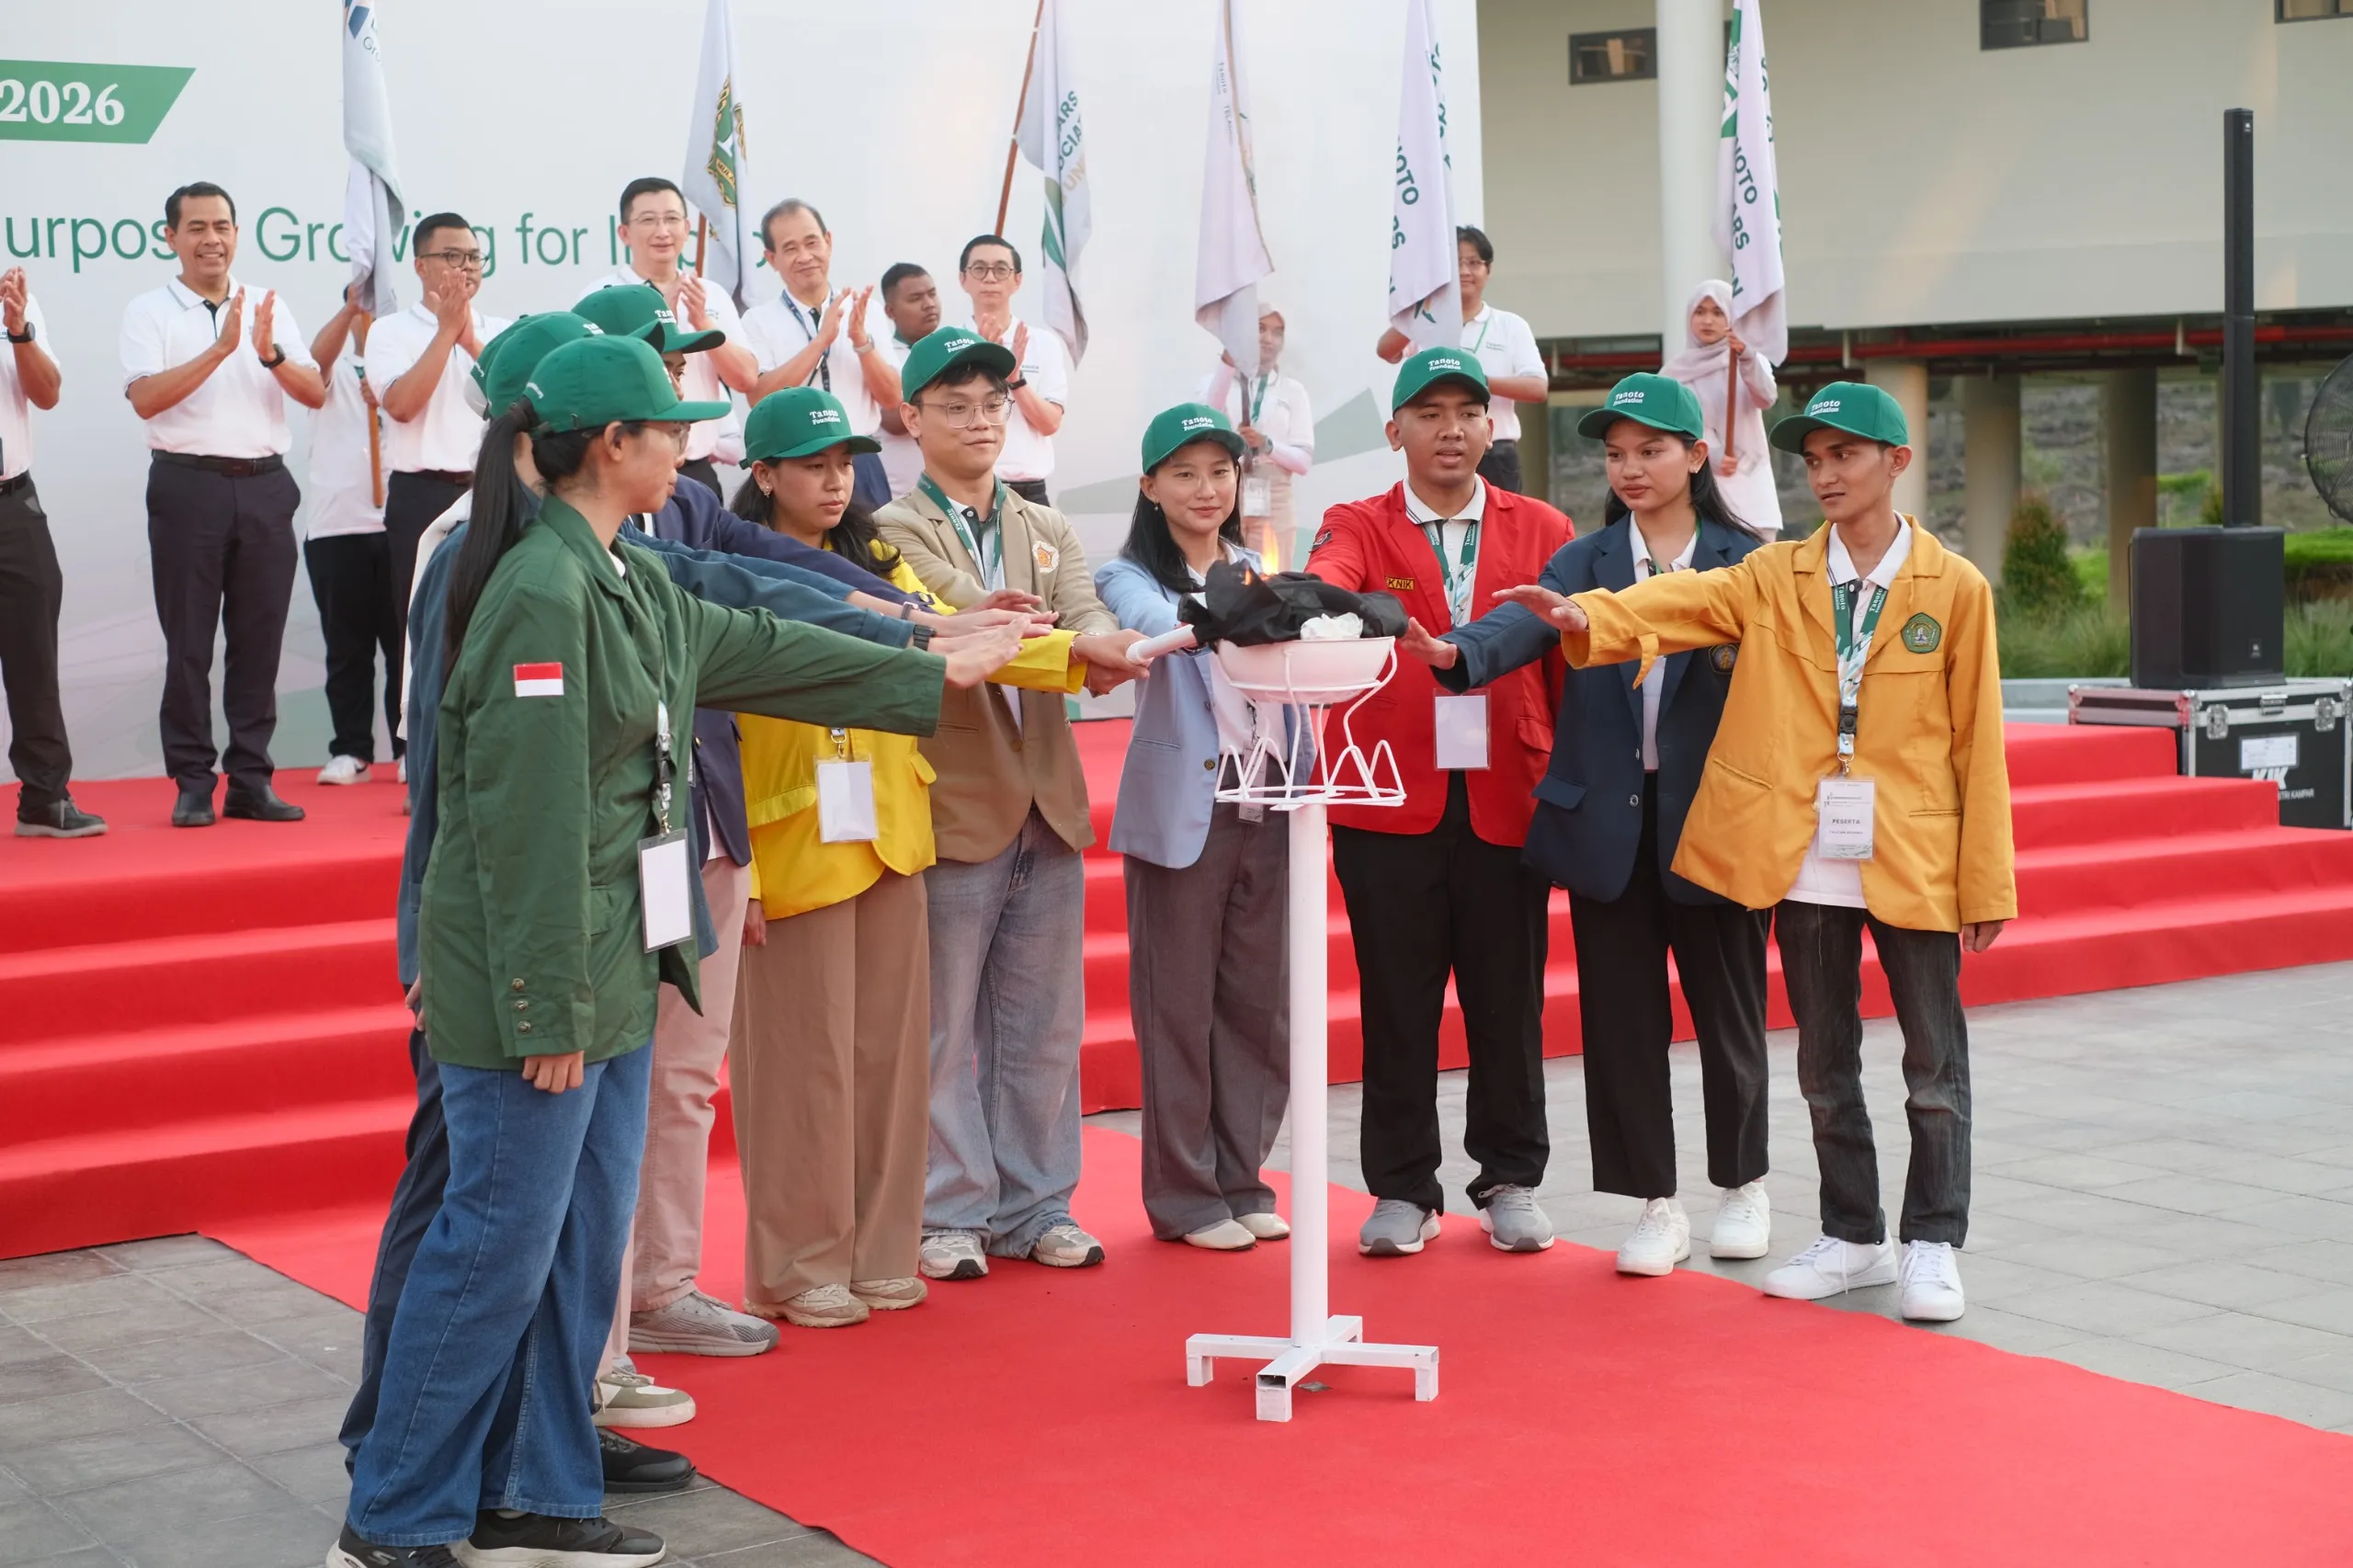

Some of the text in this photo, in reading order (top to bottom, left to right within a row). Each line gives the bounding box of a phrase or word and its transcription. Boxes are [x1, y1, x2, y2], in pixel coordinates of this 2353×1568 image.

[0, 79, 125, 126] 2026
[6, 217, 178, 273] urpos
[515, 212, 588, 266] for
[944, 337, 975, 348] Tanoto
[1427, 358, 1460, 367] Tanoto
[809, 409, 839, 419] Tanoto
[1181, 416, 1213, 426] Tanoto
[1869, 588, 1883, 612] Tanoto
